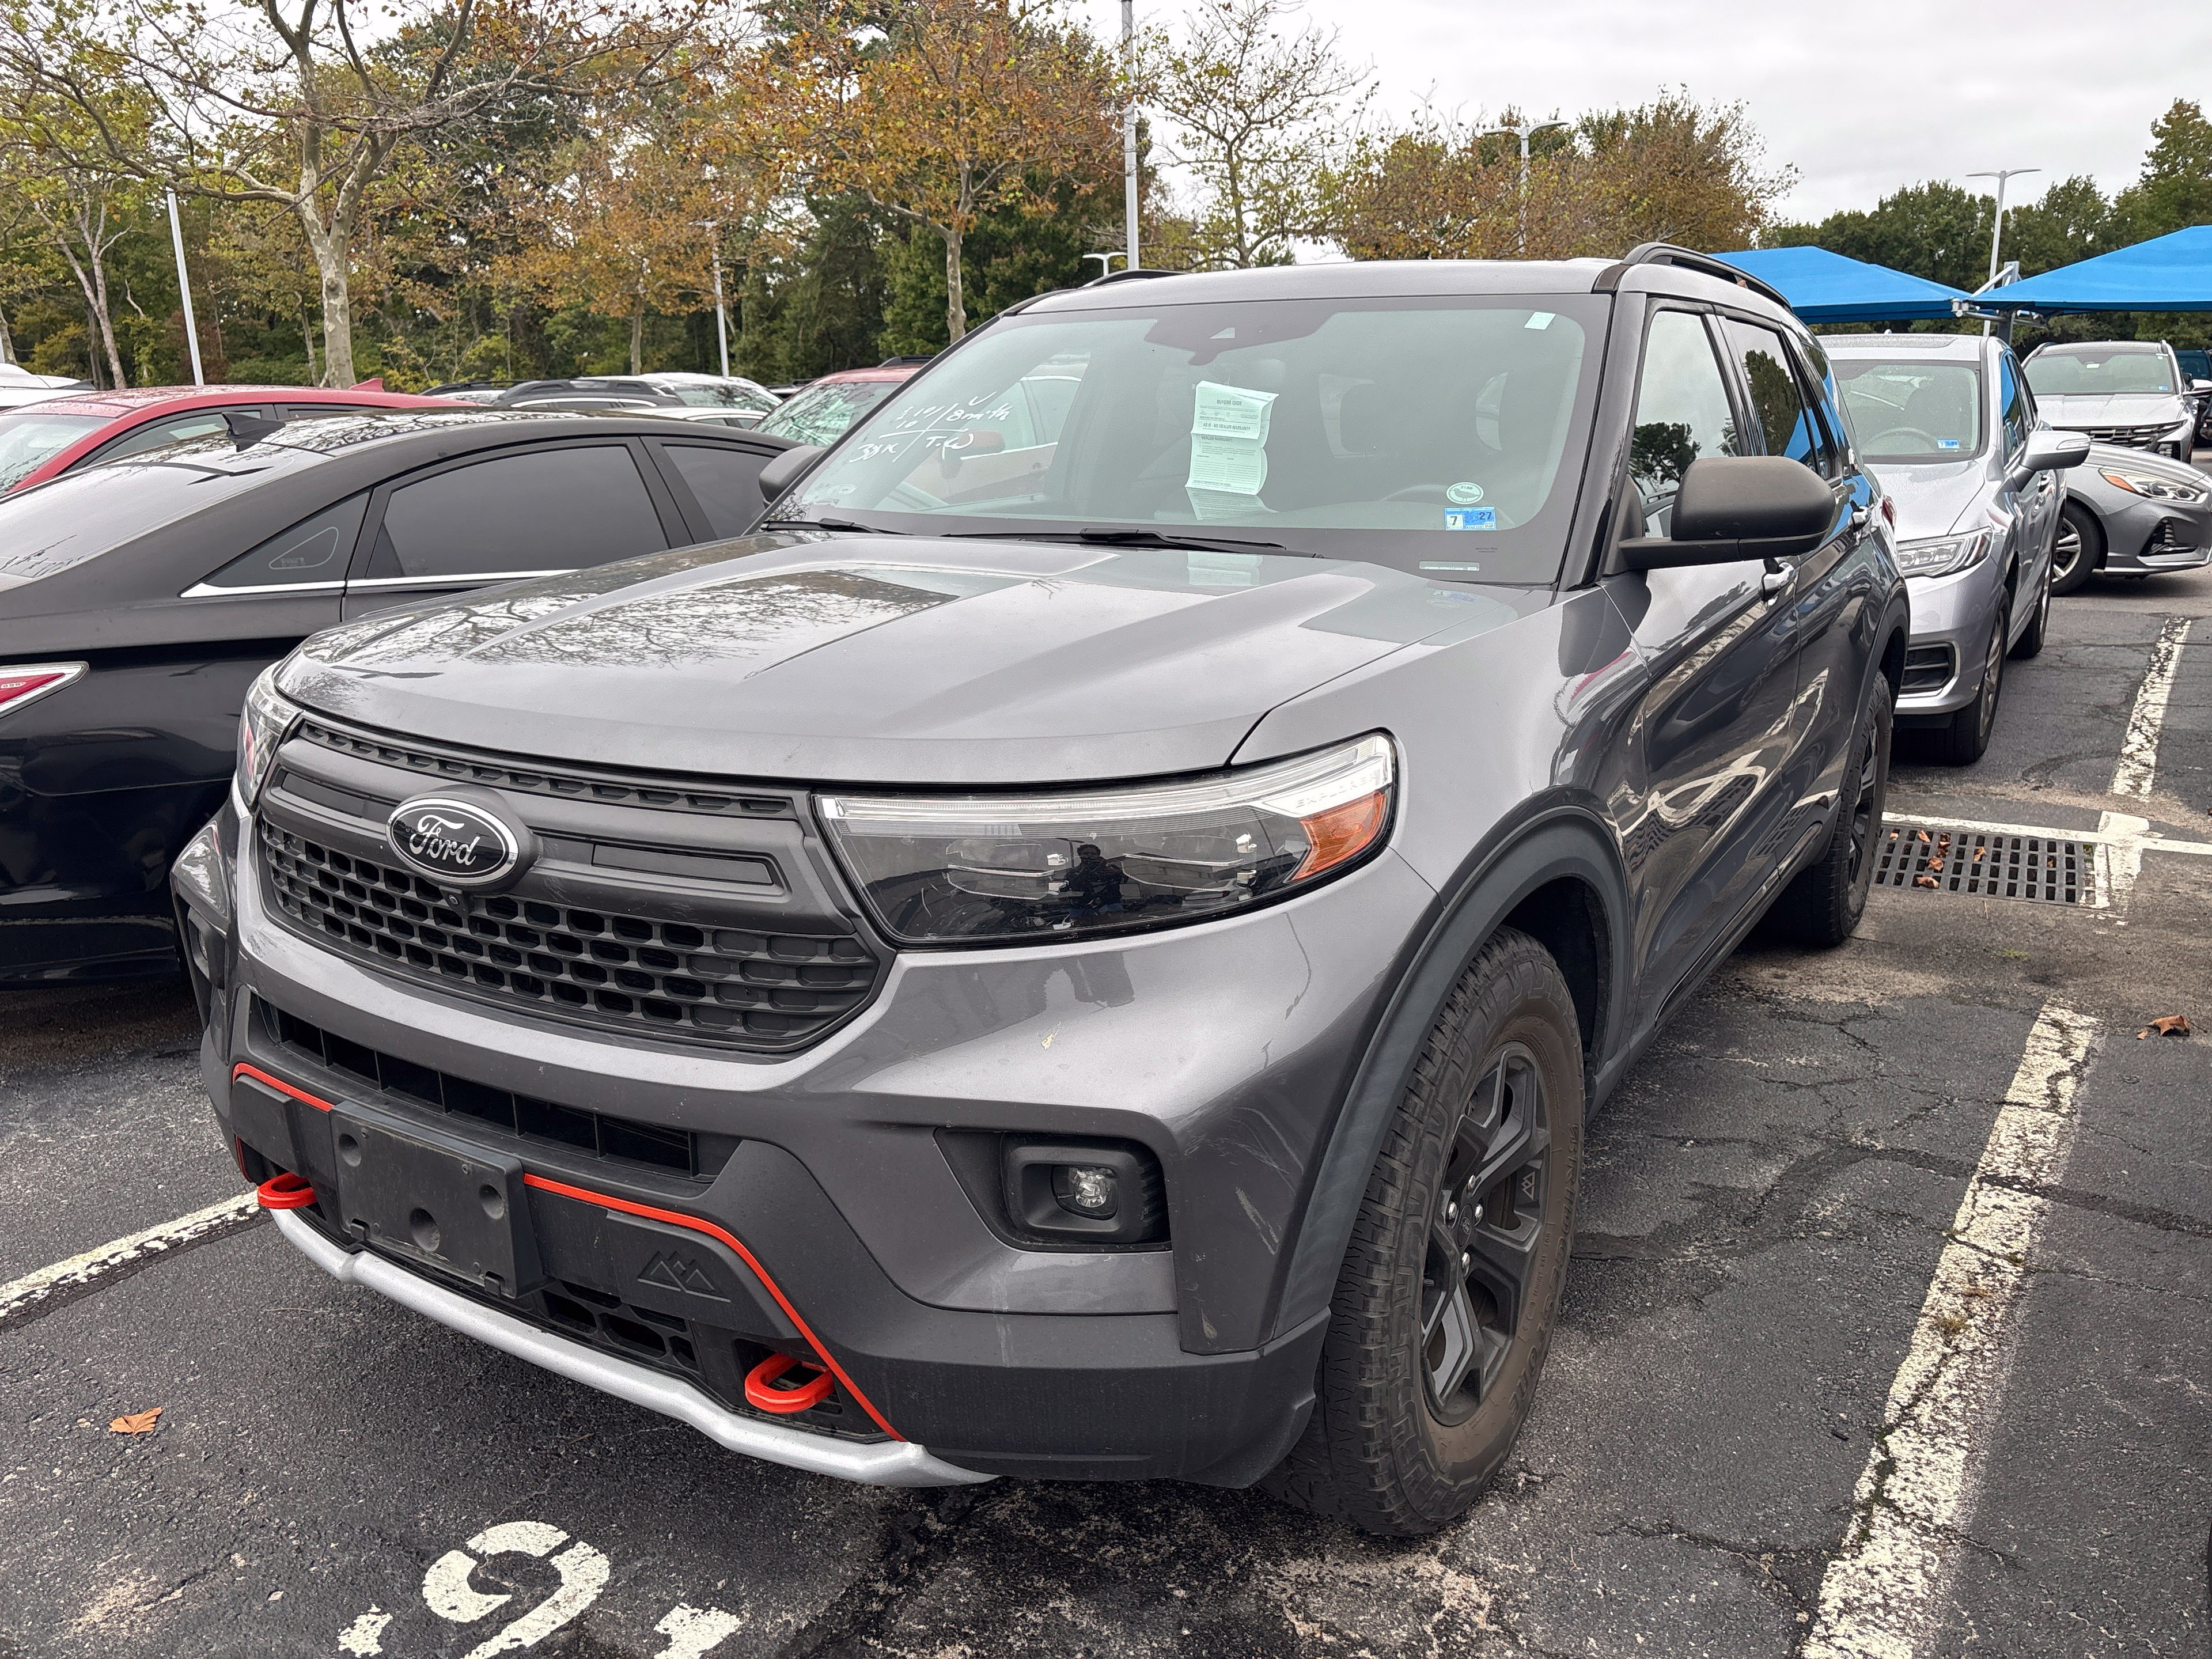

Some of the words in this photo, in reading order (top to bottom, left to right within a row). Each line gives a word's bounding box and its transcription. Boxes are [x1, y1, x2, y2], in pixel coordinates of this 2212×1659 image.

[1450, 516, 1457, 526] 7
[1479, 512, 1492, 520] 27
[409, 814, 481, 866] Ford
